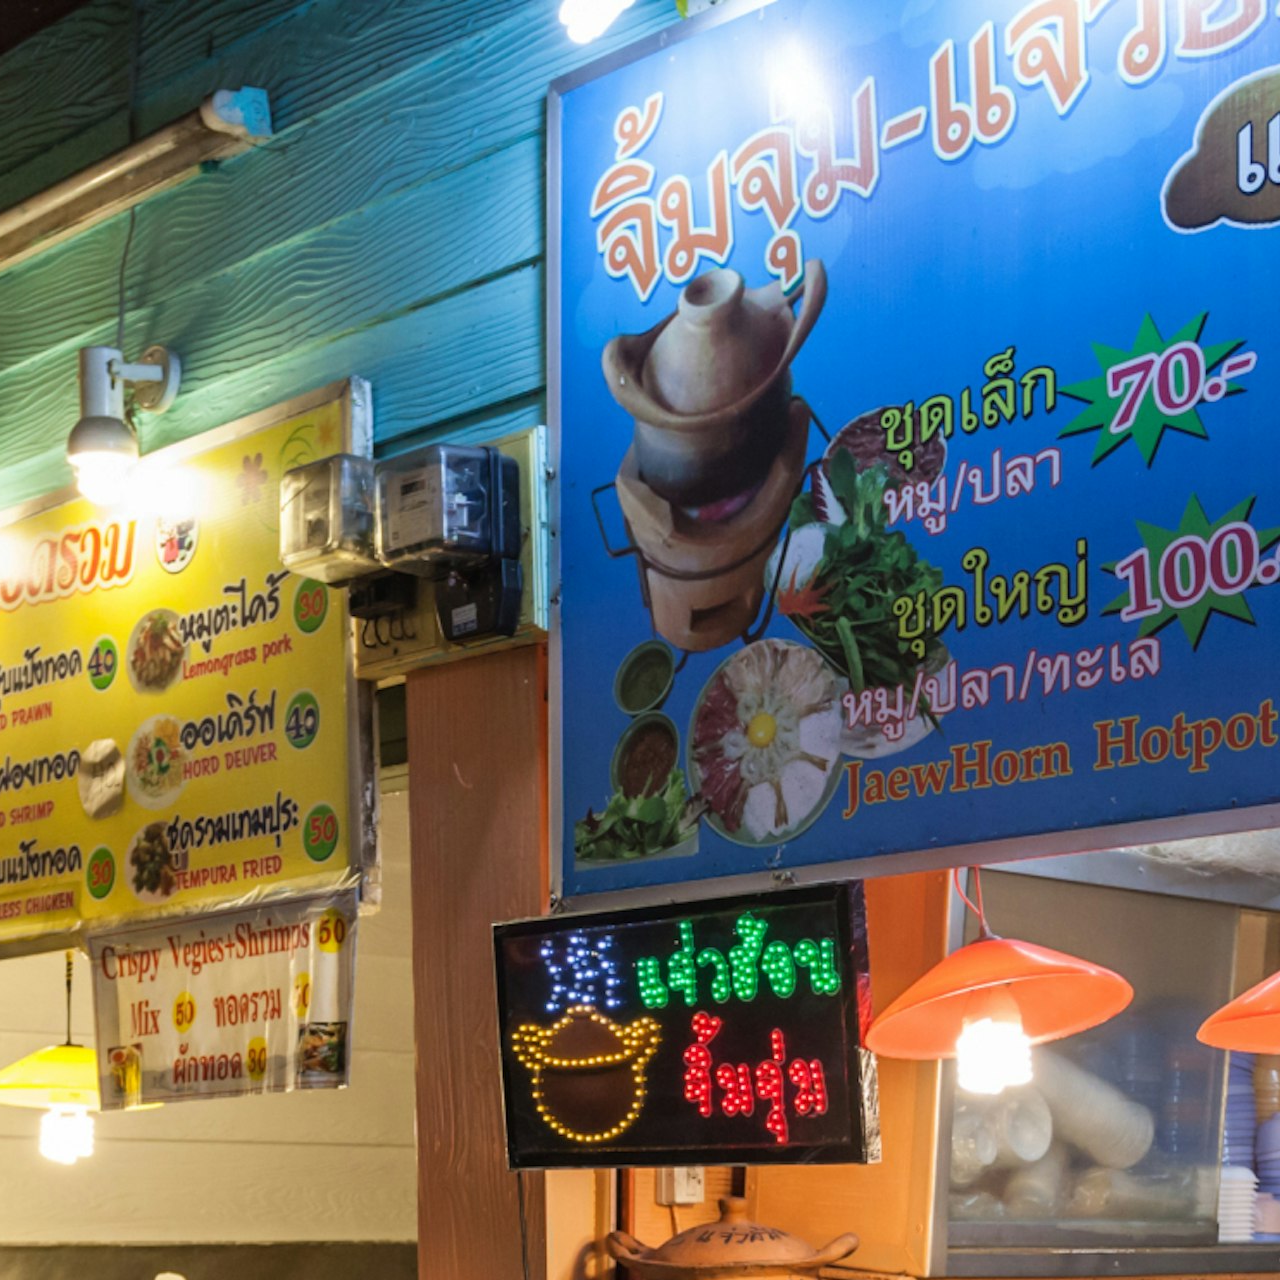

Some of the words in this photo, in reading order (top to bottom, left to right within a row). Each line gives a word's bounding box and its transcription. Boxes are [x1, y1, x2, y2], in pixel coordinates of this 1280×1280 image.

[880, 347, 1058, 470] ชุดเล็ก
[1107, 341, 1258, 434] 70.-
[884, 447, 1062, 535] หมู/ปลา
[179, 569, 290, 653] หมูตะไคร้
[300, 588, 324, 620] 30
[892, 539, 1089, 660] ชุดใหญ่
[87, 646, 115, 678] 40
[182, 646, 257, 680] Lemongrass
[262, 633, 293, 663] pork
[843, 634, 1163, 742] หมู/ปลา/ทะเล
[11, 701, 53, 727] PRAWN
[183, 755, 220, 779] HORD
[224, 742, 278, 770] DEUVER
[842, 739, 1072, 820] JaewHorn
[1094, 699, 1280, 776] Hotpot
[10, 800, 55, 826] SHRIMP
[310, 814, 337, 846] 50
[91, 859, 113, 888] 30
[175, 863, 238, 890] TEMPURA
[243, 854, 283, 880] FRIED
[25, 891, 75, 915] CHICKEN
[101, 944, 161, 983] Crispy
[167, 919, 311, 975] Vegies+Shrimps
[319, 921, 346, 944] 50
[636, 911, 841, 1009] แจ่วฮ้อน
[130, 1001, 161, 1038] Mix
[175, 1001, 195, 1026] 50
[212, 988, 282, 1028] ทอดรวม
[173, 1042, 243, 1085] ผักทอด
[247, 1047, 267, 1074] 30
[683, 1011, 828, 1144] จิ้มจุ่ม
